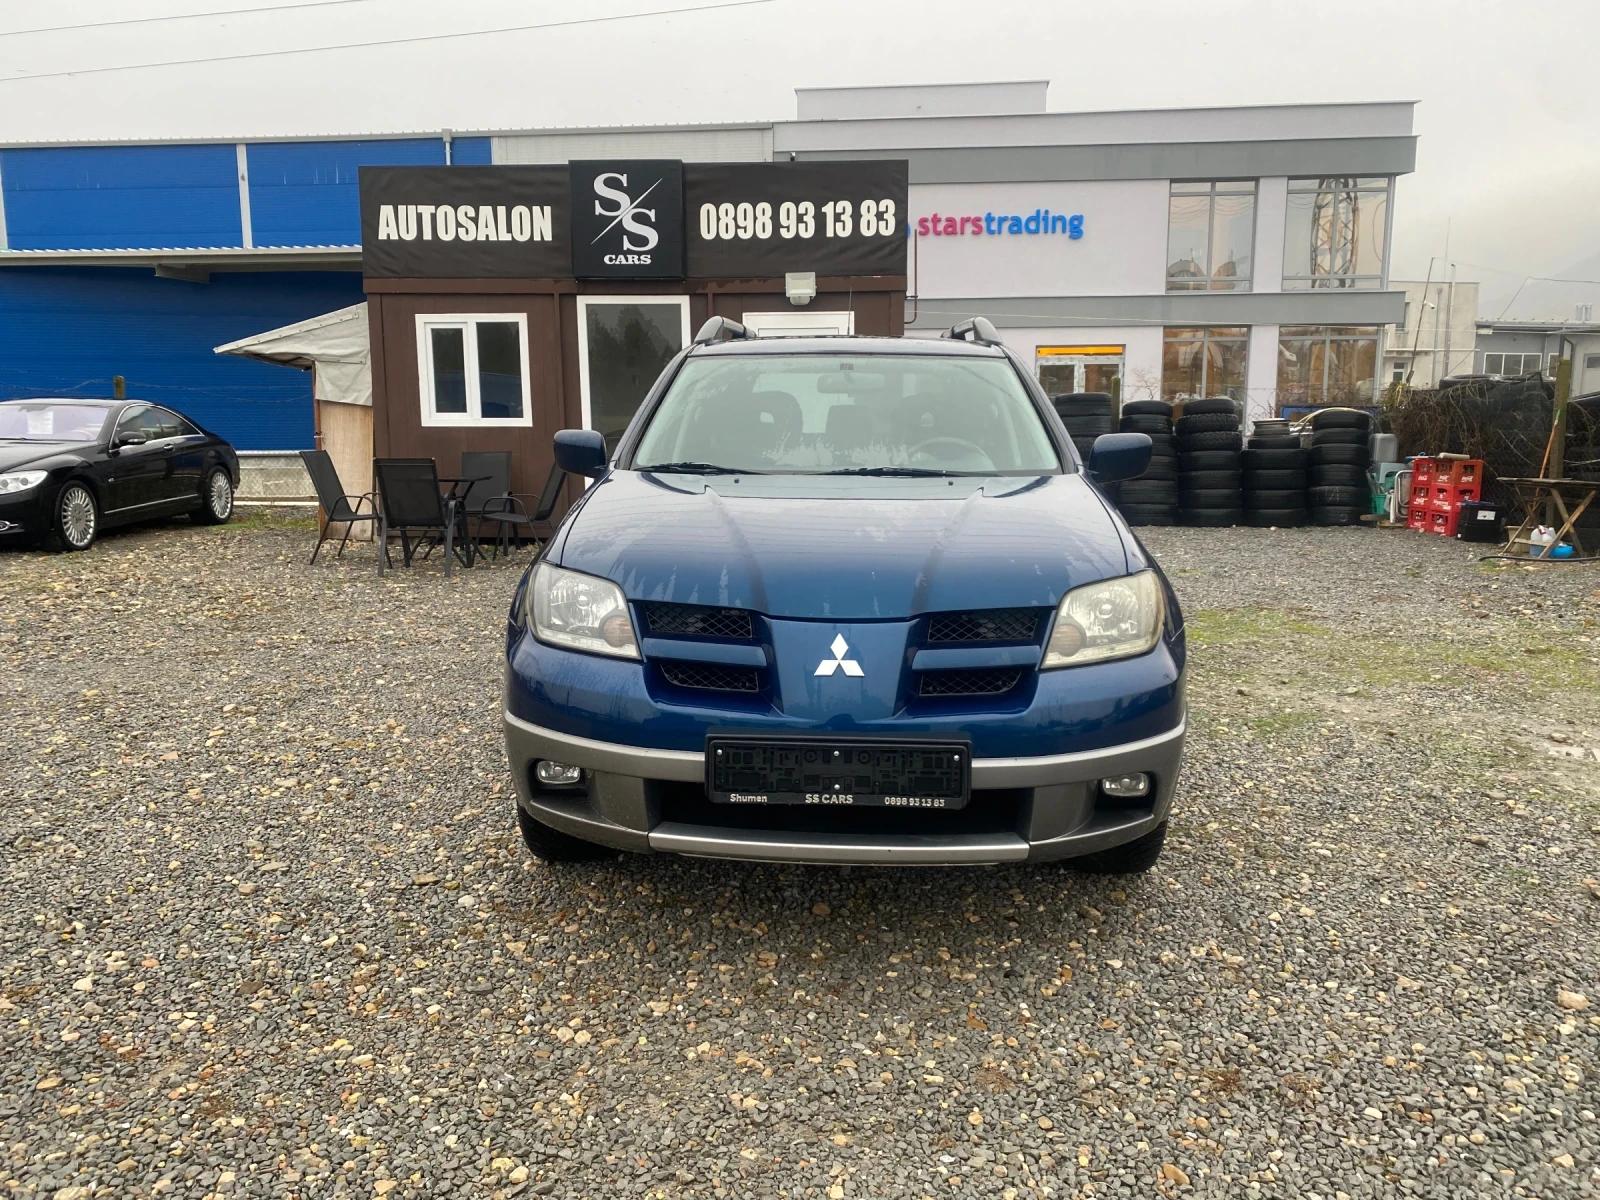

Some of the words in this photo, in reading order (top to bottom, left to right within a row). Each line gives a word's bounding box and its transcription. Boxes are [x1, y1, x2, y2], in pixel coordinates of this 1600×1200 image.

[378, 204, 553, 242] AUTOSALON
[700, 201, 773, 240] 0898
[779, 201, 815, 239] 93
[821, 199, 853, 238] 13
[860, 198, 896, 237] 83
[603, 254, 652, 265] CARS
[729, 793, 768, 803] Shumen
[805, 793, 820, 804] SS
[821, 794, 854, 805] CARS
[884, 796, 908, 806] 0898
[909, 797, 920, 806] 93
[921, 798, 932, 807] 13
[933, 798, 945, 807] 83
